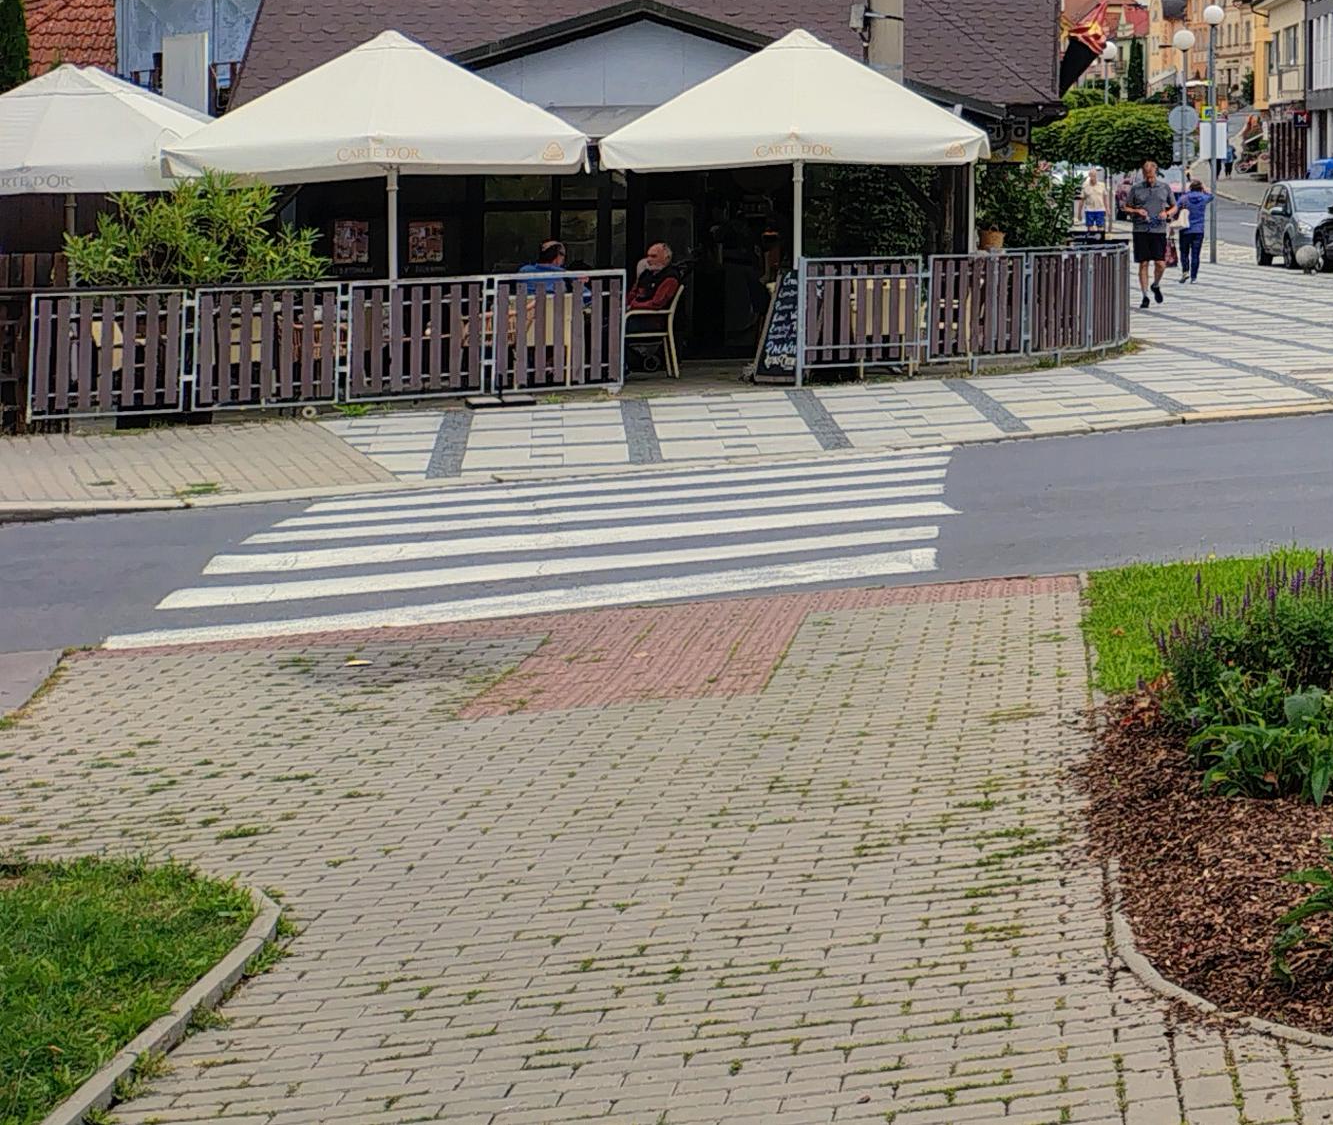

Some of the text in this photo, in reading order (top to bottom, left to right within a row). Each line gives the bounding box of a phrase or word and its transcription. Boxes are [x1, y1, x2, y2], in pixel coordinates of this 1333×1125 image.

[336, 146, 422, 162] CARTE D'OR
[756, 143, 833, 158] CARTE D'OR
